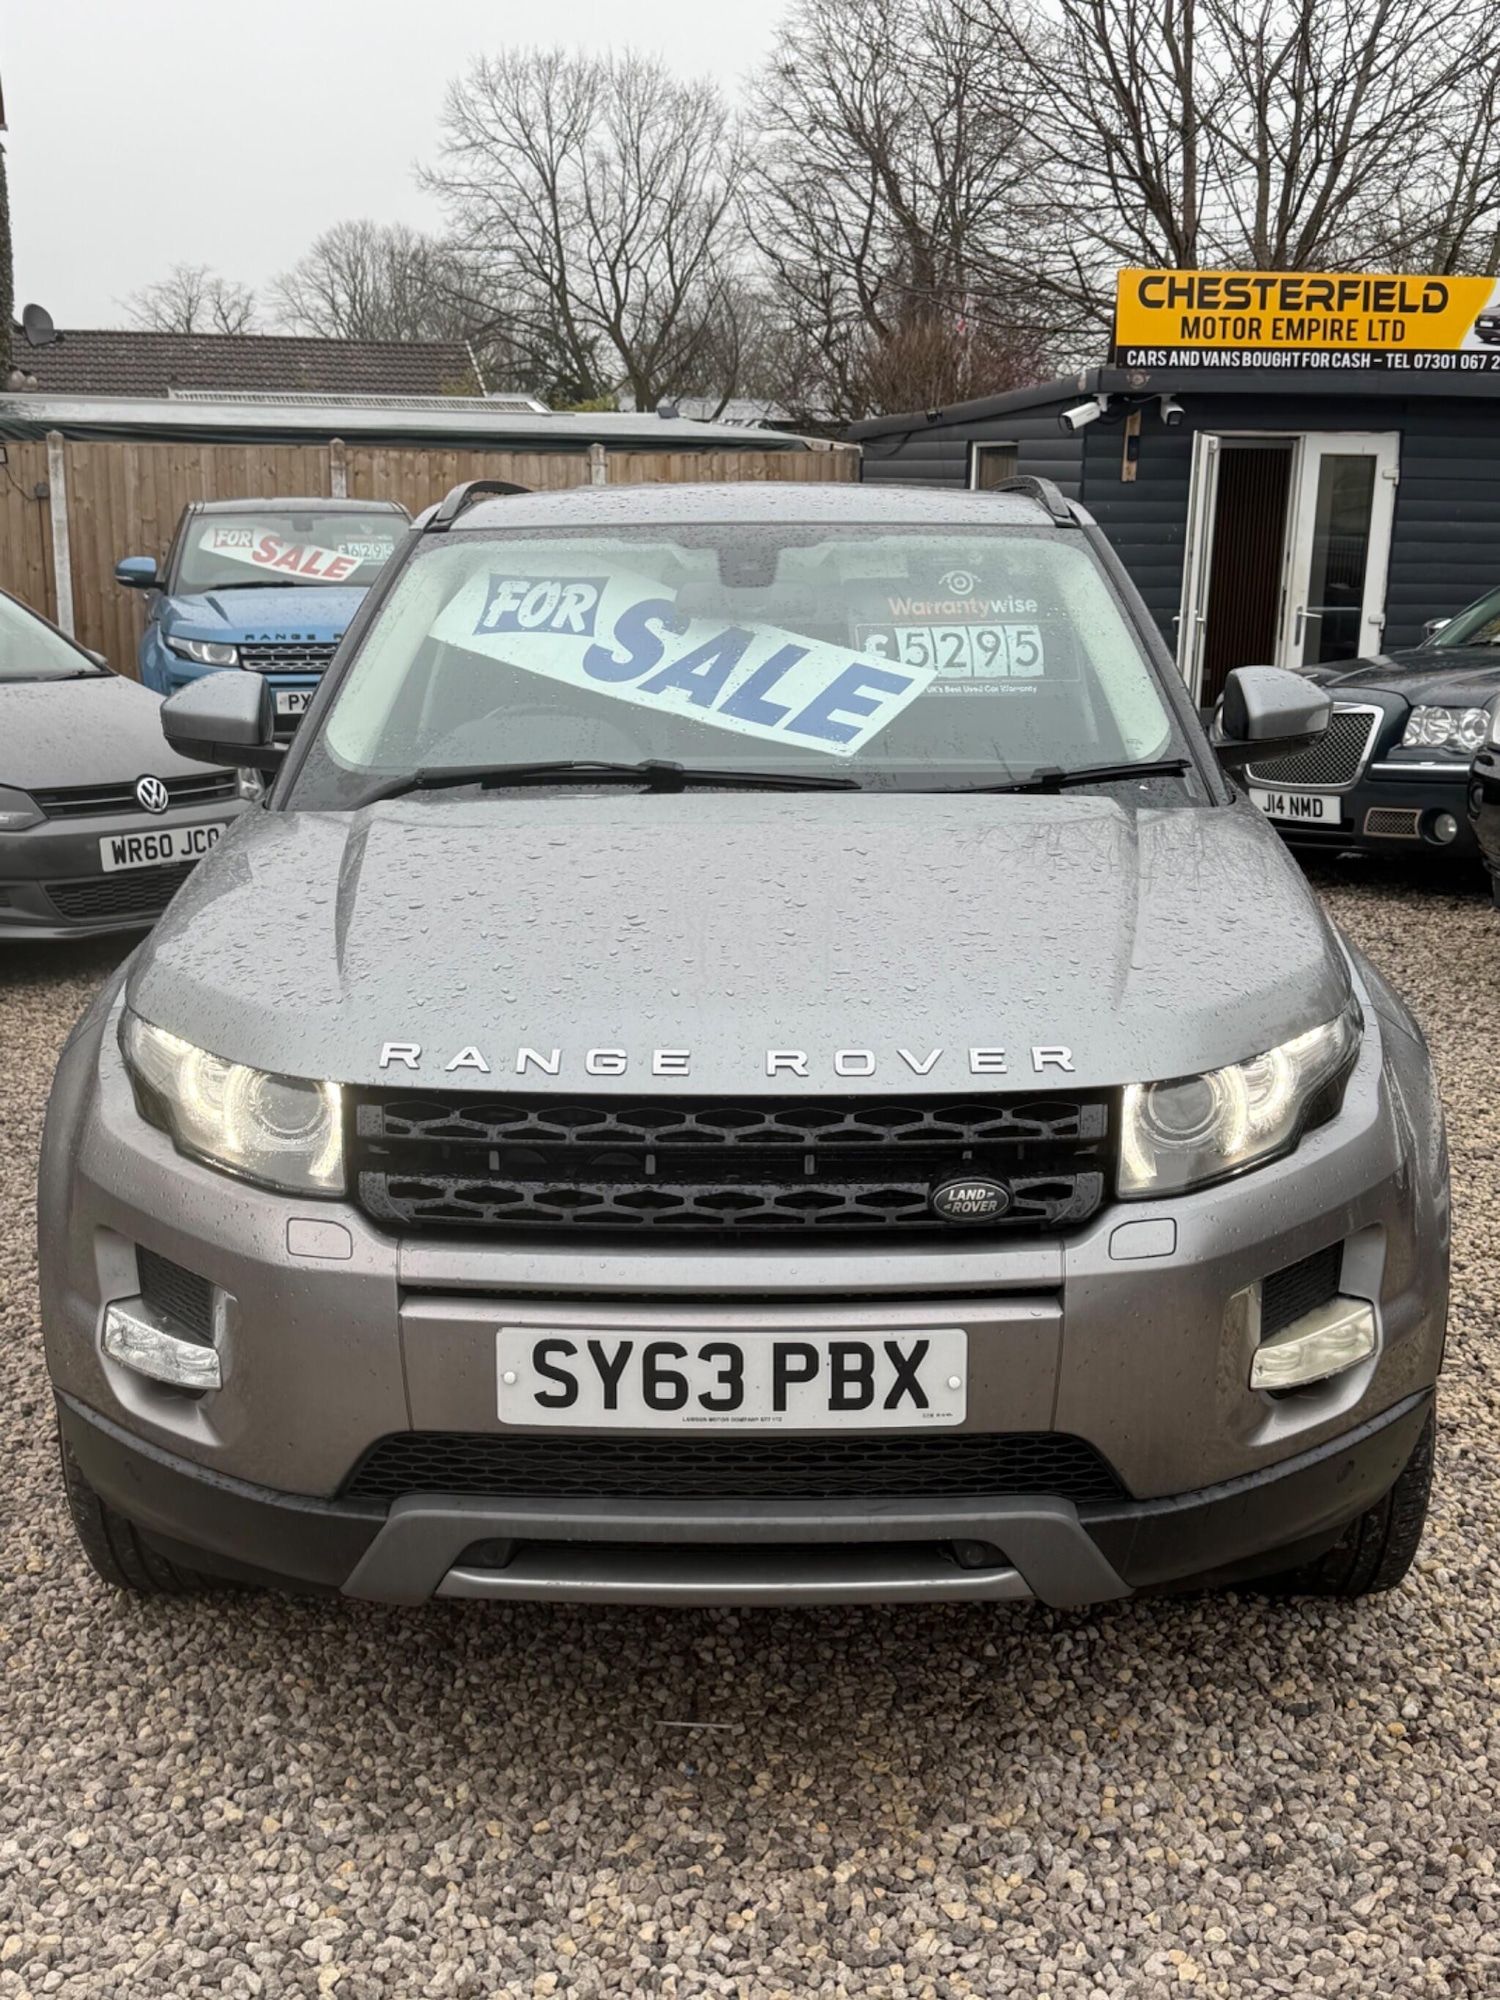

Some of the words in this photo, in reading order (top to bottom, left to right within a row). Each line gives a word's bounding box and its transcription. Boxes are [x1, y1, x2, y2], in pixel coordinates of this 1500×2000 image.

[1138, 275, 1449, 313] CHESTERFIELD
[1180, 316, 1261, 340] MOTOR
[1272, 318, 1358, 342] EMPIRE
[1368, 320, 1405, 342] LTD
[1127, 350, 1167, 366] CARS
[1168, 350, 1200, 366] AND
[1202, 351, 1240, 367] VANS
[1242, 351, 1301, 367] BOUGHT
[1302, 352, 1330, 368] FOR
[1331, 353, 1371, 368] CASH
[1385, 353, 1410, 368] TEL
[1413, 354, 1456, 369] 07301
[1460, 354, 1487, 370] 067
[216, 529, 252, 547] FOR
[252, 535, 357, 579] SALE
[887, 595, 1038, 618] Warrantywise
[244, 633, 316, 641] RANGE
[483, 579, 588, 633] FOR
[583, 598, 915, 745] SALE
[1263, 793, 1285, 814] J14
[1290, 796, 1323, 818] NMD
[111, 833, 173, 865] WR60
[378, 1042, 691, 1076] RANGE
[766, 1045, 1076, 1077] ROVER
[951, 1200, 998, 1213] ROVER
[532, 1338, 744, 1411] SY63
[772, 1339, 930, 1411] PBX
